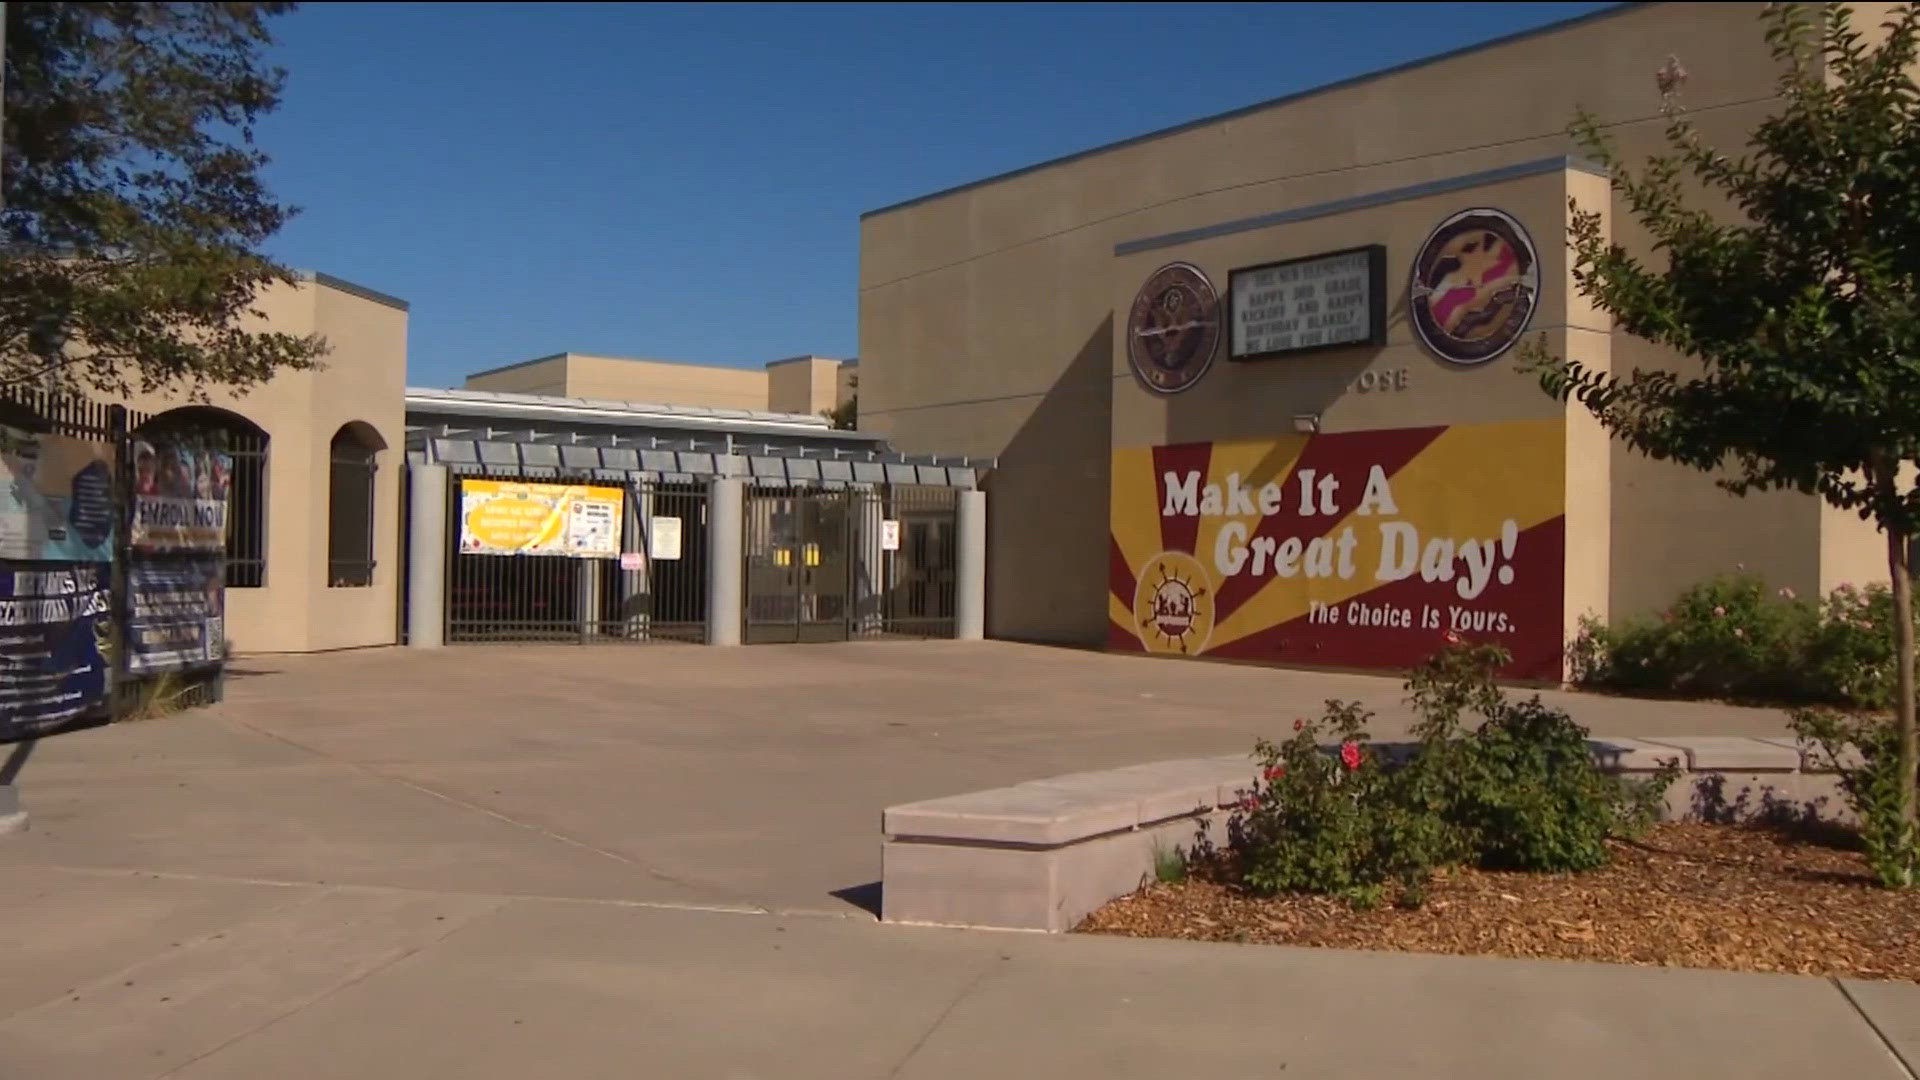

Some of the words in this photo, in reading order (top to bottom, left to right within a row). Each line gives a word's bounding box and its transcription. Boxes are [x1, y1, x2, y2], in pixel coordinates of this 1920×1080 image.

[1163, 470, 1281, 517] Make
[1297, 468, 1340, 516] It
[1356, 464, 1399, 516] A
[141, 500, 190, 527] ENROLL
[194, 502, 224, 528] NOW
[1214, 520, 1357, 580] Great
[1375, 518, 1519, 600] Day!
[1309, 601, 1339, 625] The
[1347, 601, 1412, 628] Choice
[1421, 604, 1440, 629] Is
[1449, 605, 1516, 633] Yours.
